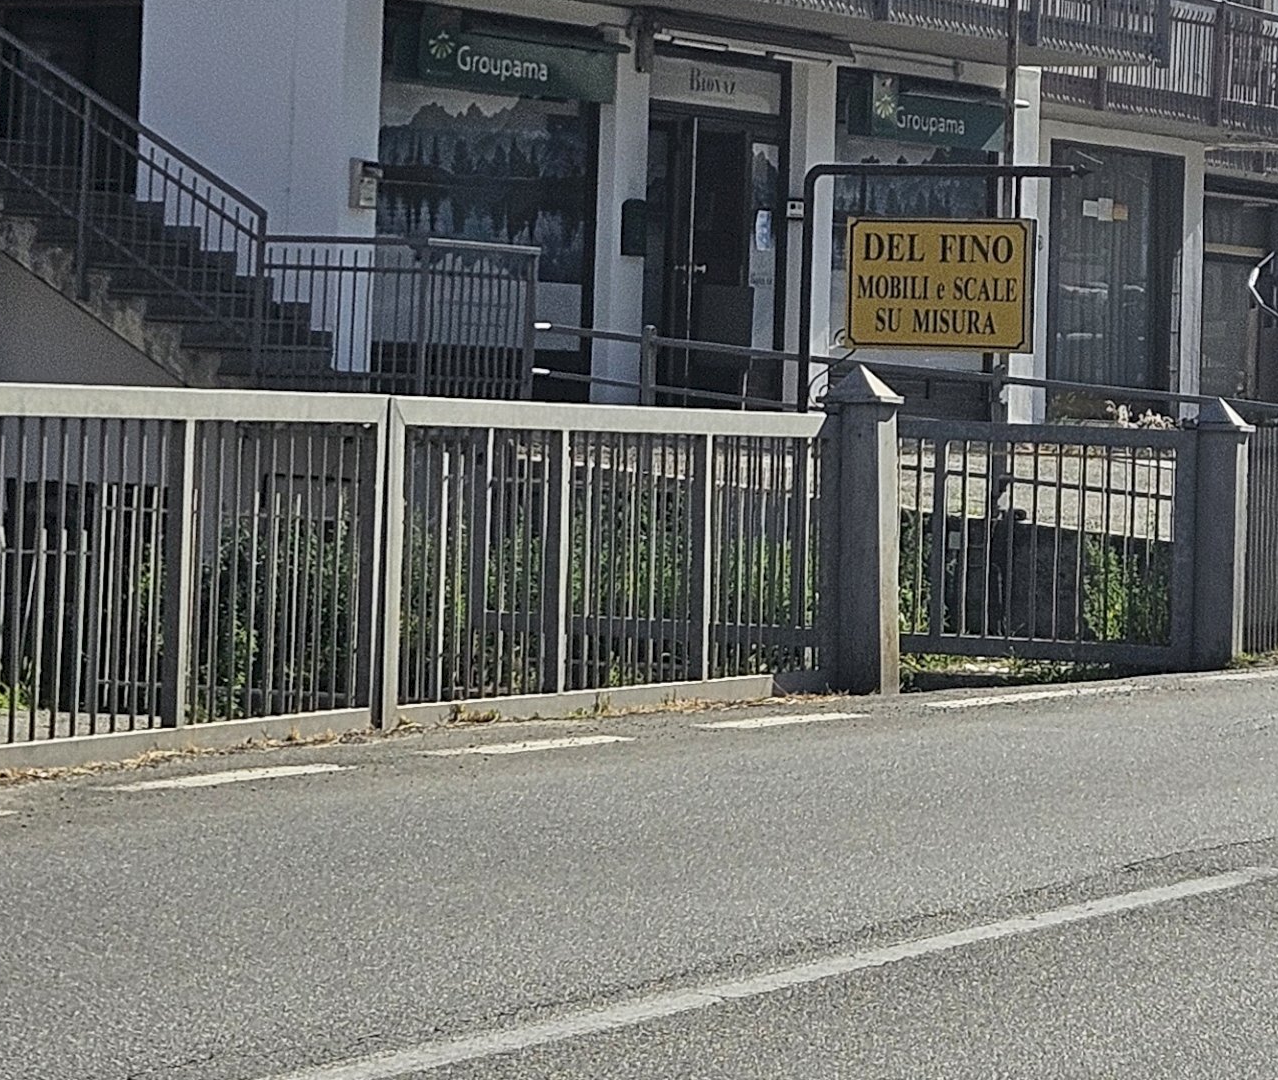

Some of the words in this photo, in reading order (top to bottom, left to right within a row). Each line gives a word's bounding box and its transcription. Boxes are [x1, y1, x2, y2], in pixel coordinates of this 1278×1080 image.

[457, 45, 548, 82] Groupama
[896, 105, 965, 137] Groupama
[863, 232, 926, 262] DEL
[939, 234, 1014, 264] FINO
[857, 274, 929, 300] MOBILI
[936, 282, 946, 300] e
[953, 276, 1018, 302] SCALE
[875, 307, 902, 332] SU
[912, 308, 996, 335] MISURA
